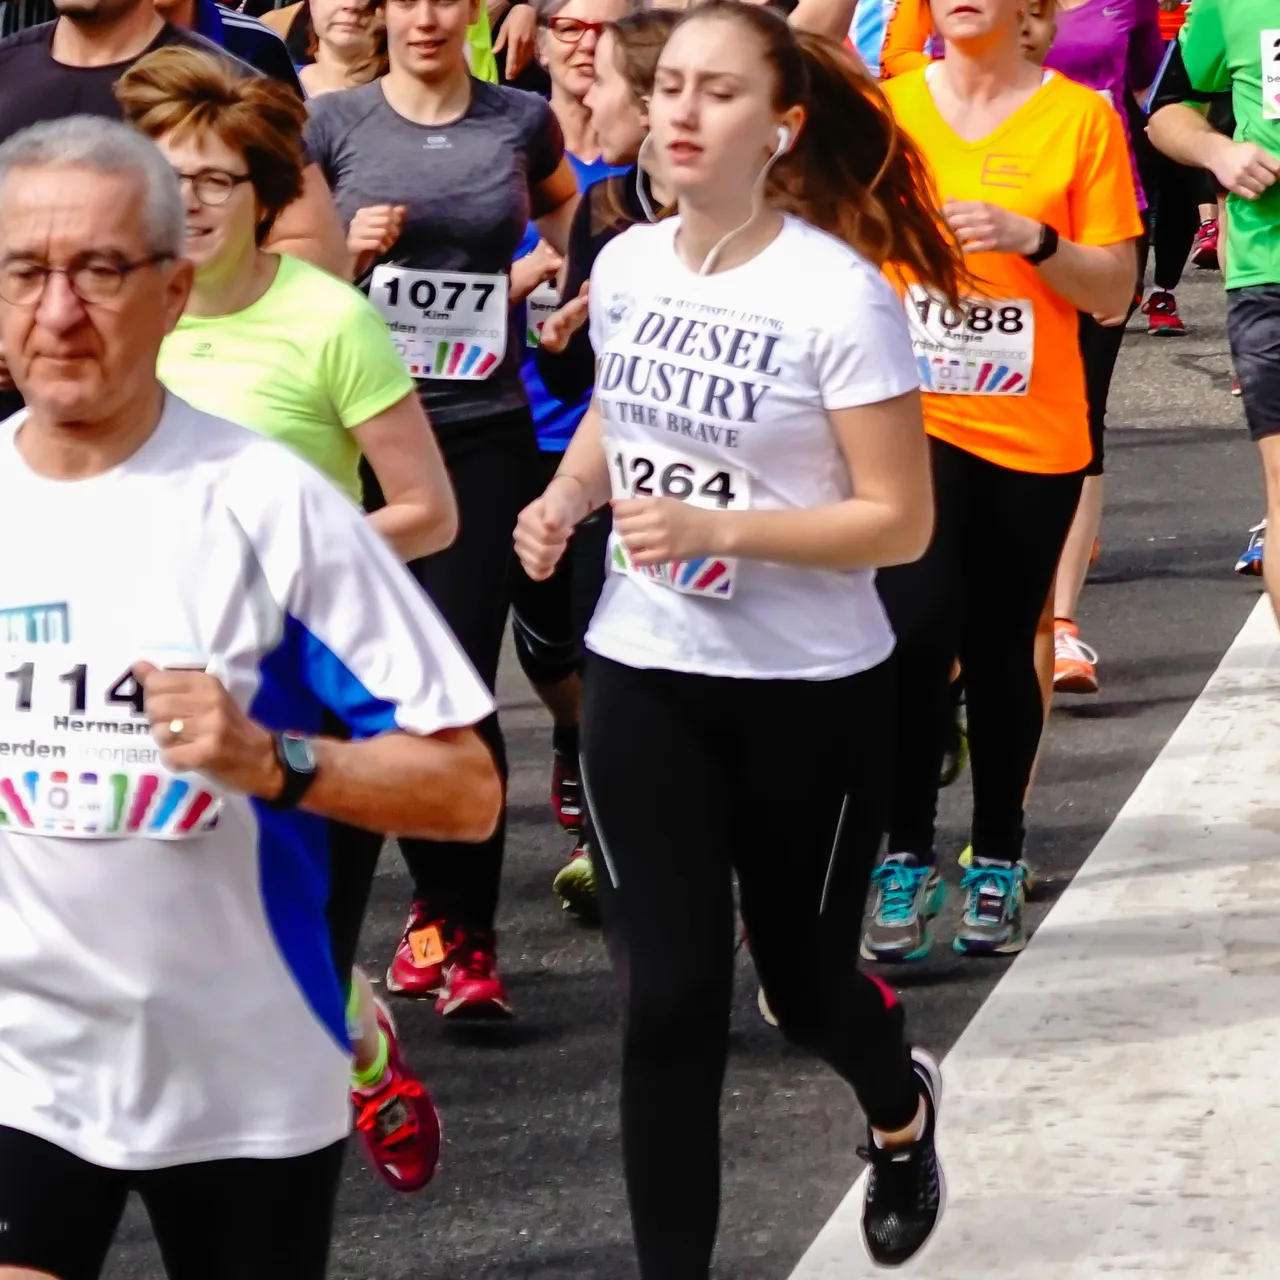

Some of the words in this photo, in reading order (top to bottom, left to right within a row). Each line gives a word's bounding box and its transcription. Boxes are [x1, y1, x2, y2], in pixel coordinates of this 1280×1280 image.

[383, 276, 496, 313] 1077
[421, 309, 450, 321] Kim
[632, 310, 782, 378] DIESEL
[615, 401, 660, 428] THE
[665, 411, 740, 449] BRAVE
[614, 452, 736, 510] 1264
